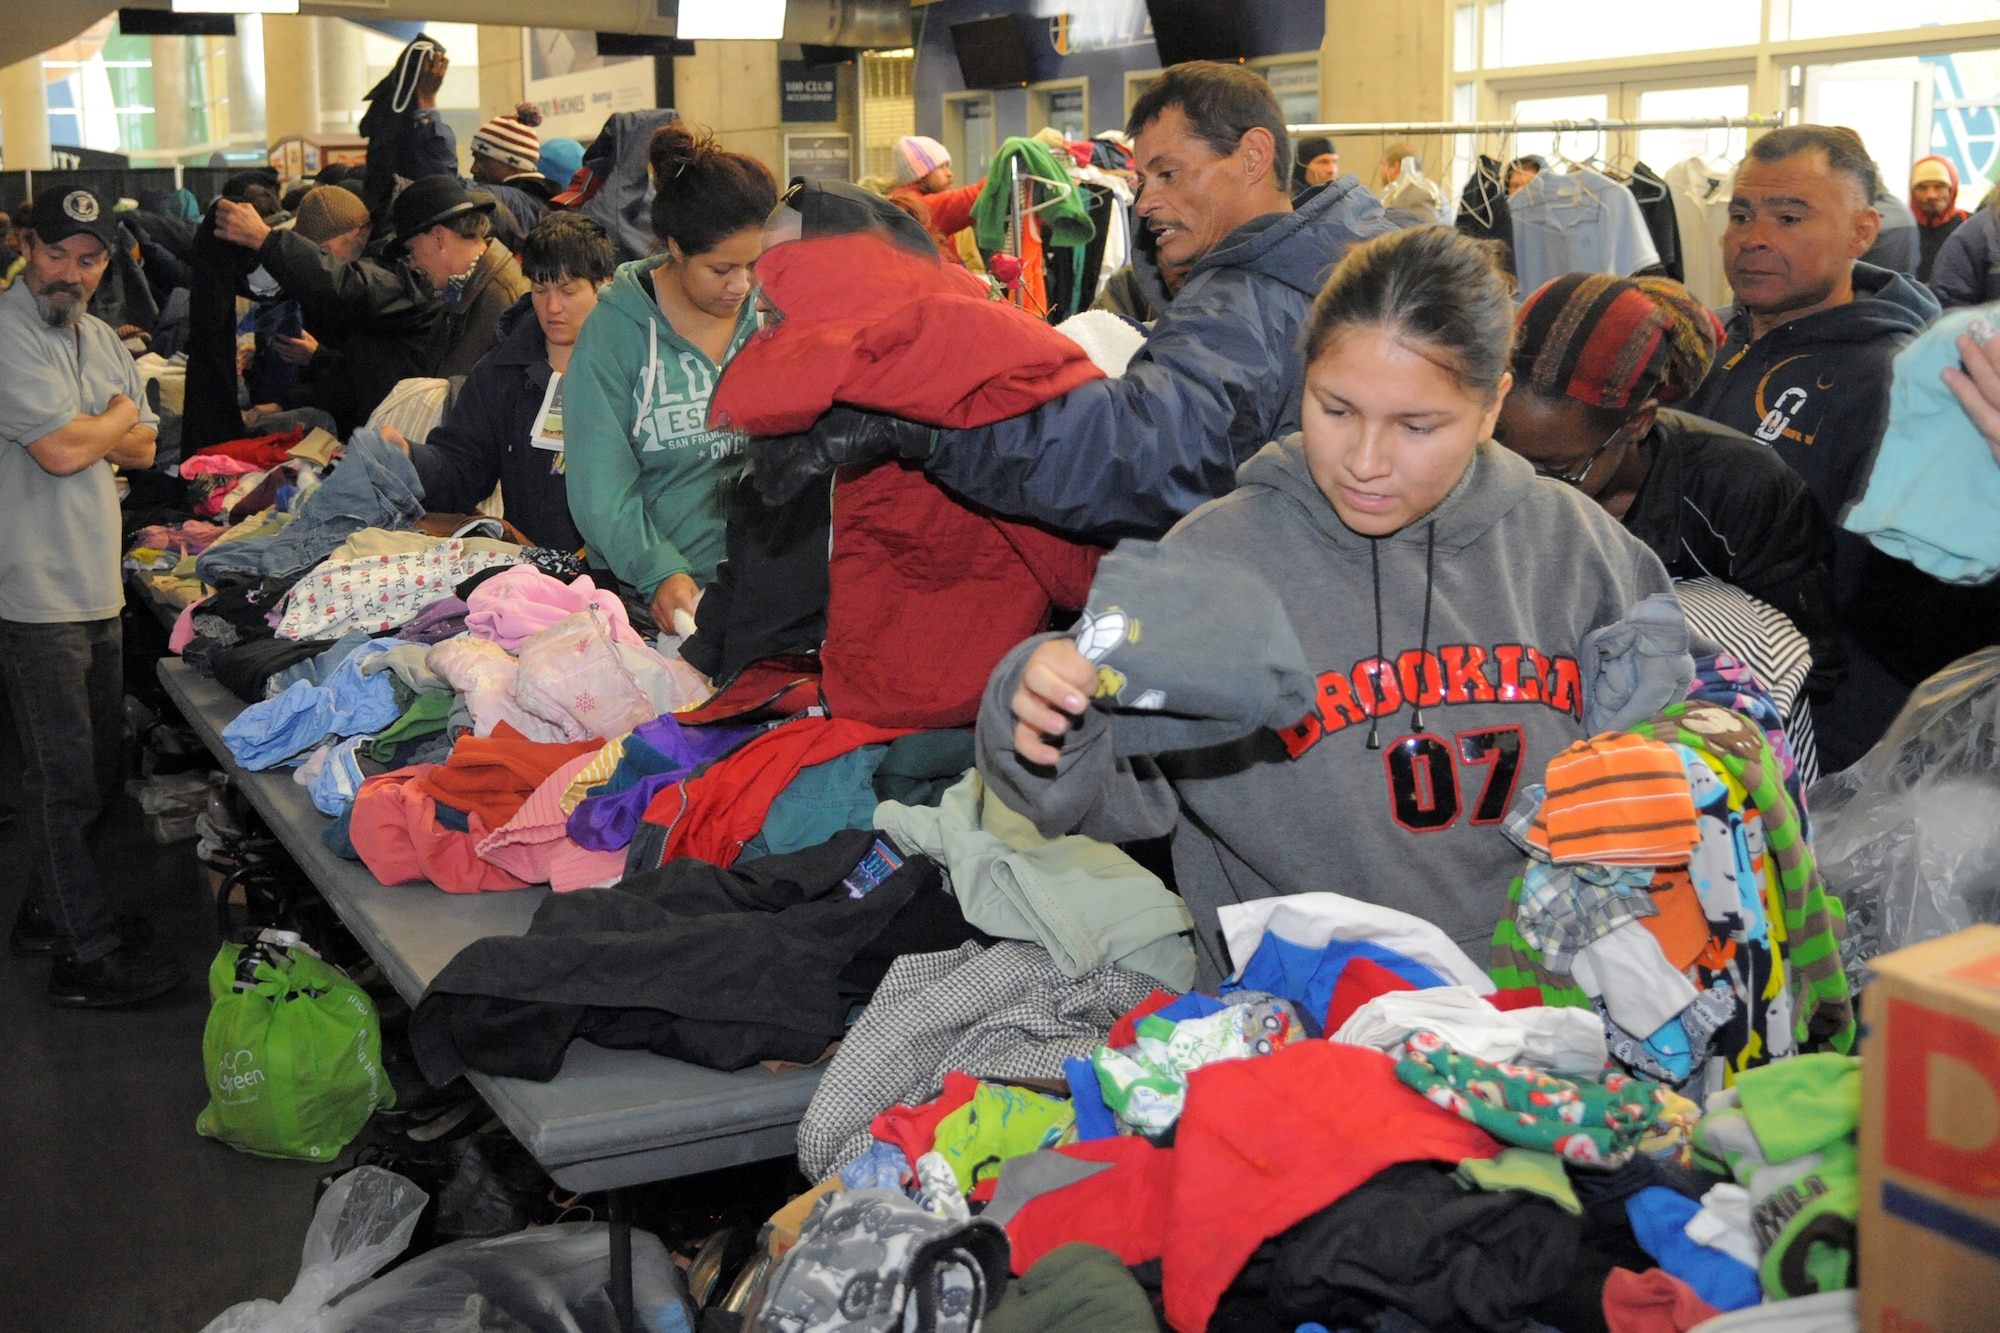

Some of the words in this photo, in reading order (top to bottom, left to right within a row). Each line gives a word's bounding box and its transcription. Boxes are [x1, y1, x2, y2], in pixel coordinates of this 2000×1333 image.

[667, 406, 708, 434] ES
[668, 437, 690, 450] SAN
[1382, 723, 1526, 834] 07
